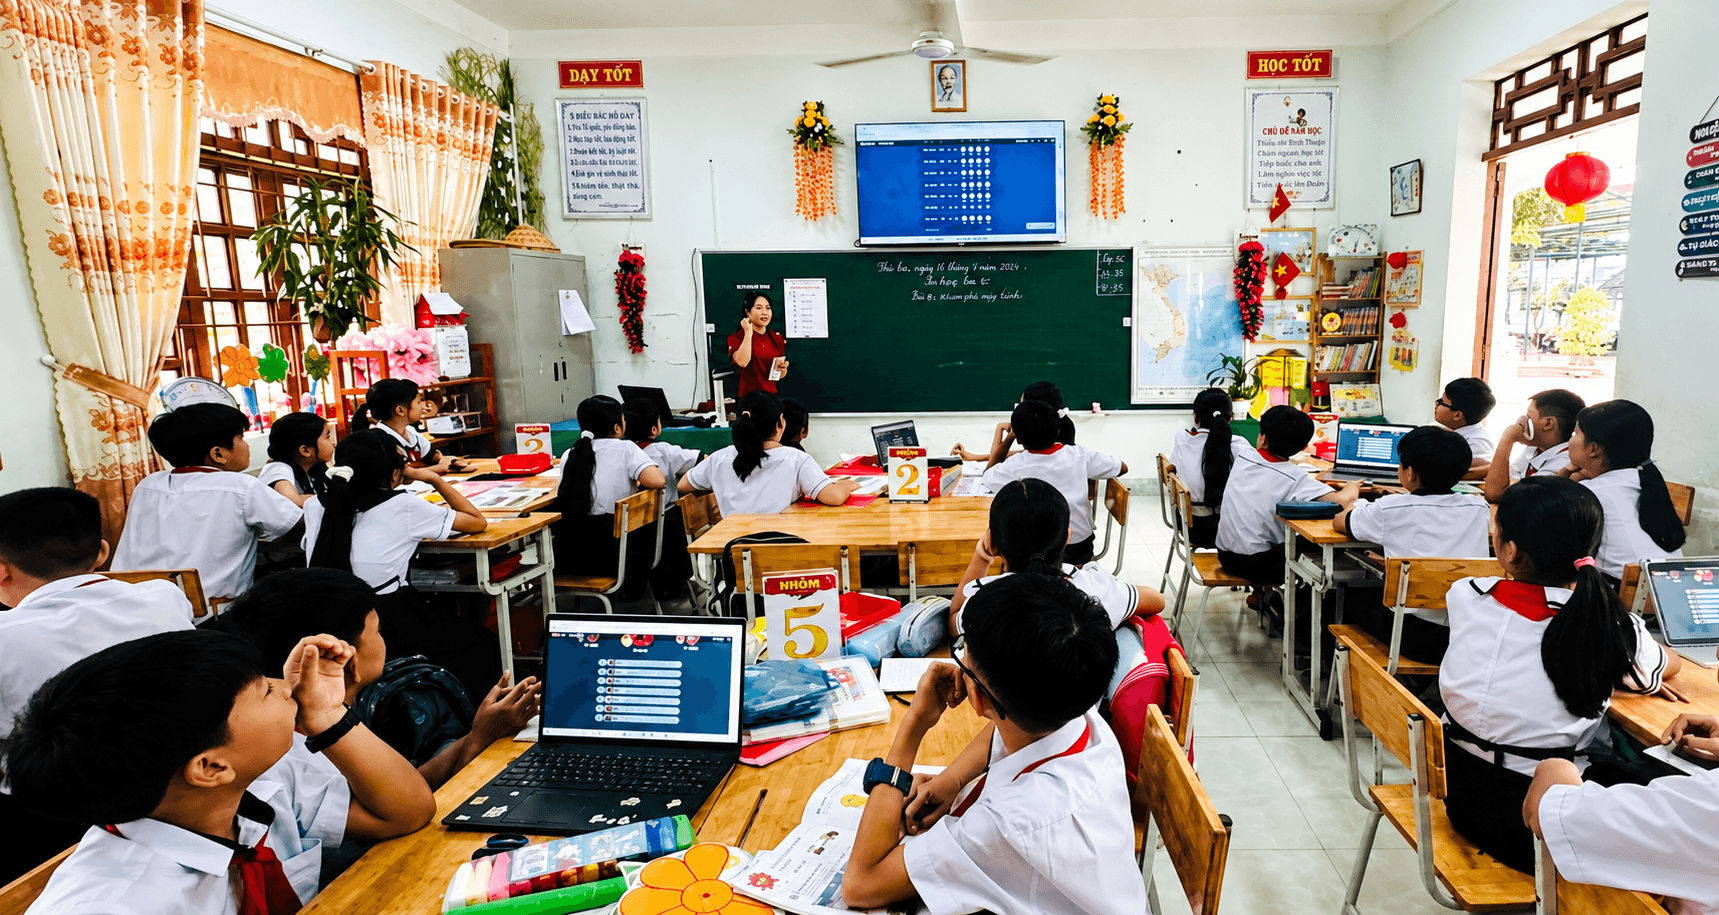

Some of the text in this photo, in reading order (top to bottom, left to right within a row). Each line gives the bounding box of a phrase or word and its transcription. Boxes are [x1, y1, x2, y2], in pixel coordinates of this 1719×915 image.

[569, 63, 632, 85] DẠY TỐT
[1258, 53, 1322, 76] HỌC TỐT
[936, 263, 945, 271] 16
[1000, 263, 1020, 271] 2024
[896, 464, 920, 495] 2
[784, 602, 829, 659] 5
